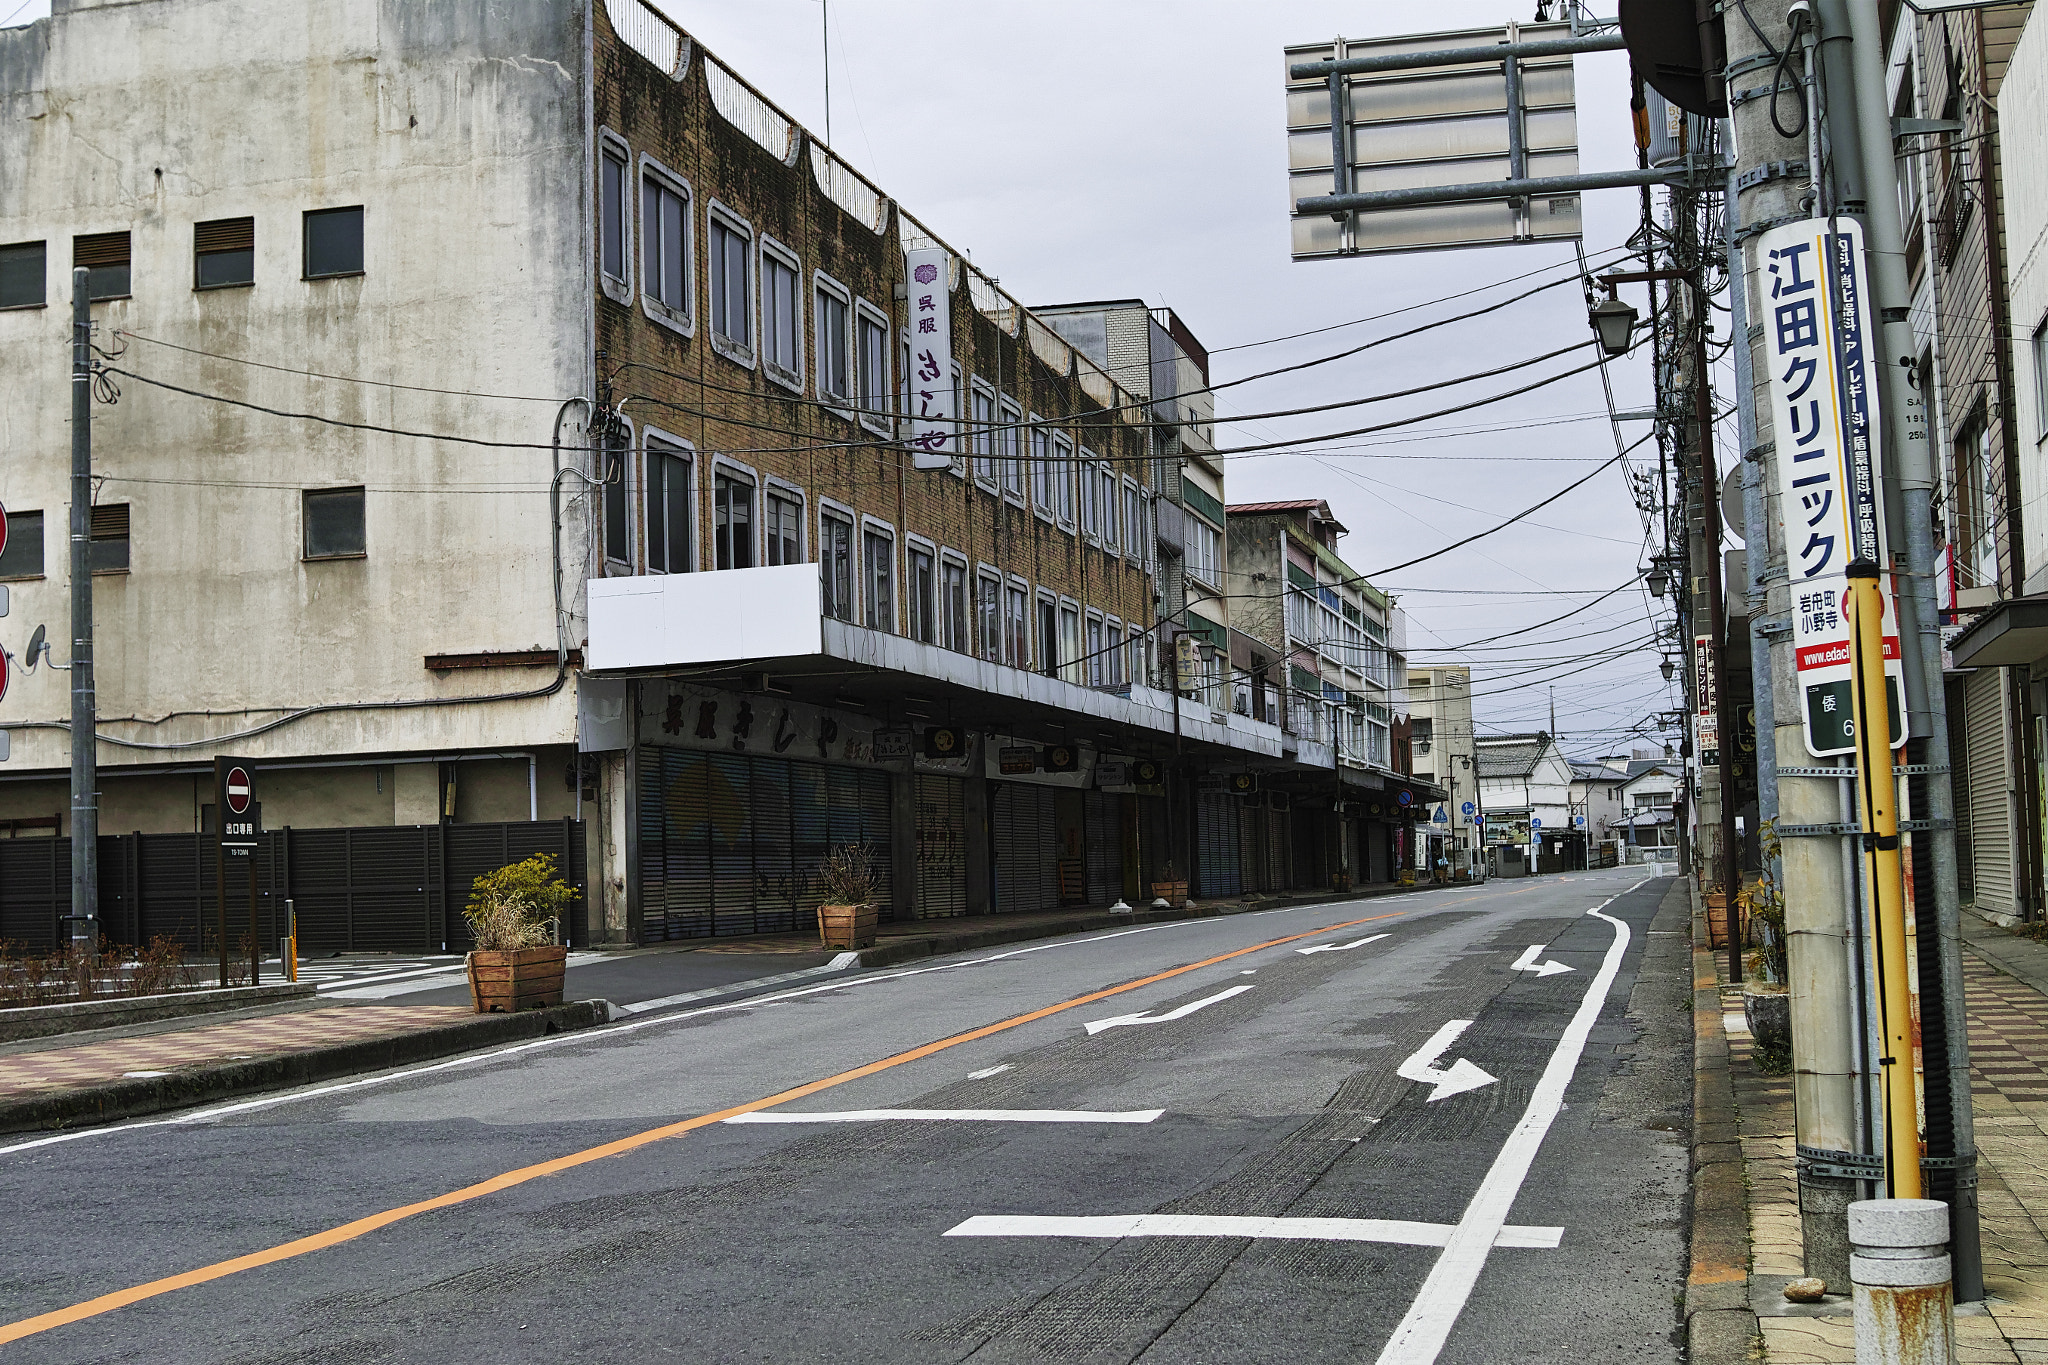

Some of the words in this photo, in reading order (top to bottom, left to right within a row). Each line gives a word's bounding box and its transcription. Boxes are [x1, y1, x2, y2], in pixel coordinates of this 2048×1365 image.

[918, 294, 938, 334] 呉服
[1767, 242, 1835, 578] 江田クリニック
[1799, 589, 1836, 615] 岩舟町
[1801, 611, 1838, 634] 小野寺
[225, 822, 253, 835] 出口専用
